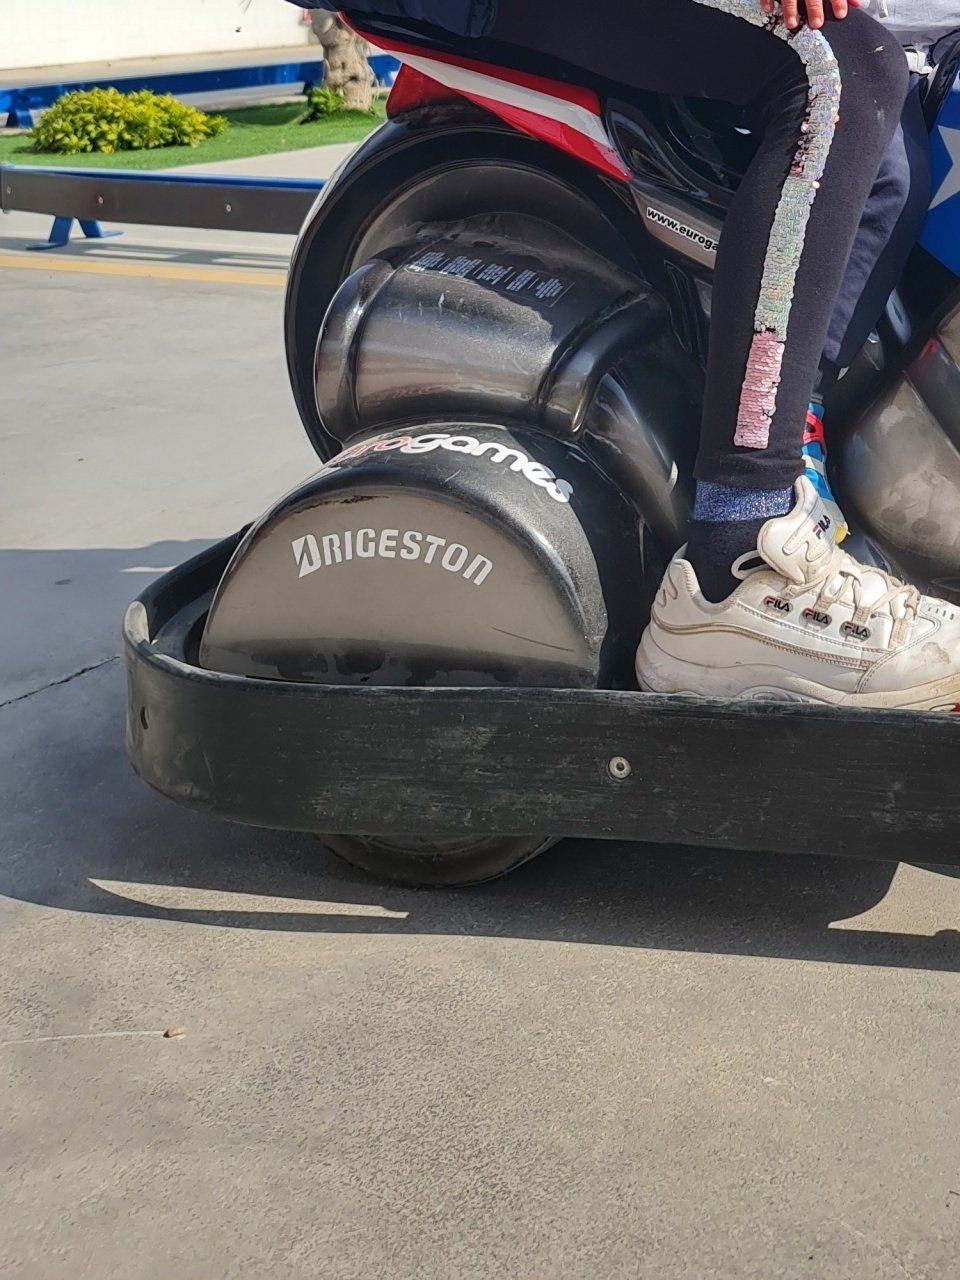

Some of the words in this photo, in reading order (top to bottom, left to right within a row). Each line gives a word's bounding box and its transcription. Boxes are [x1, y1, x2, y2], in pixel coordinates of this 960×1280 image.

[812, 514, 831, 540] FILA
[766, 595, 790, 612] FILA
[804, 608, 829, 625] FILA
[844, 621, 869, 638] FILA
